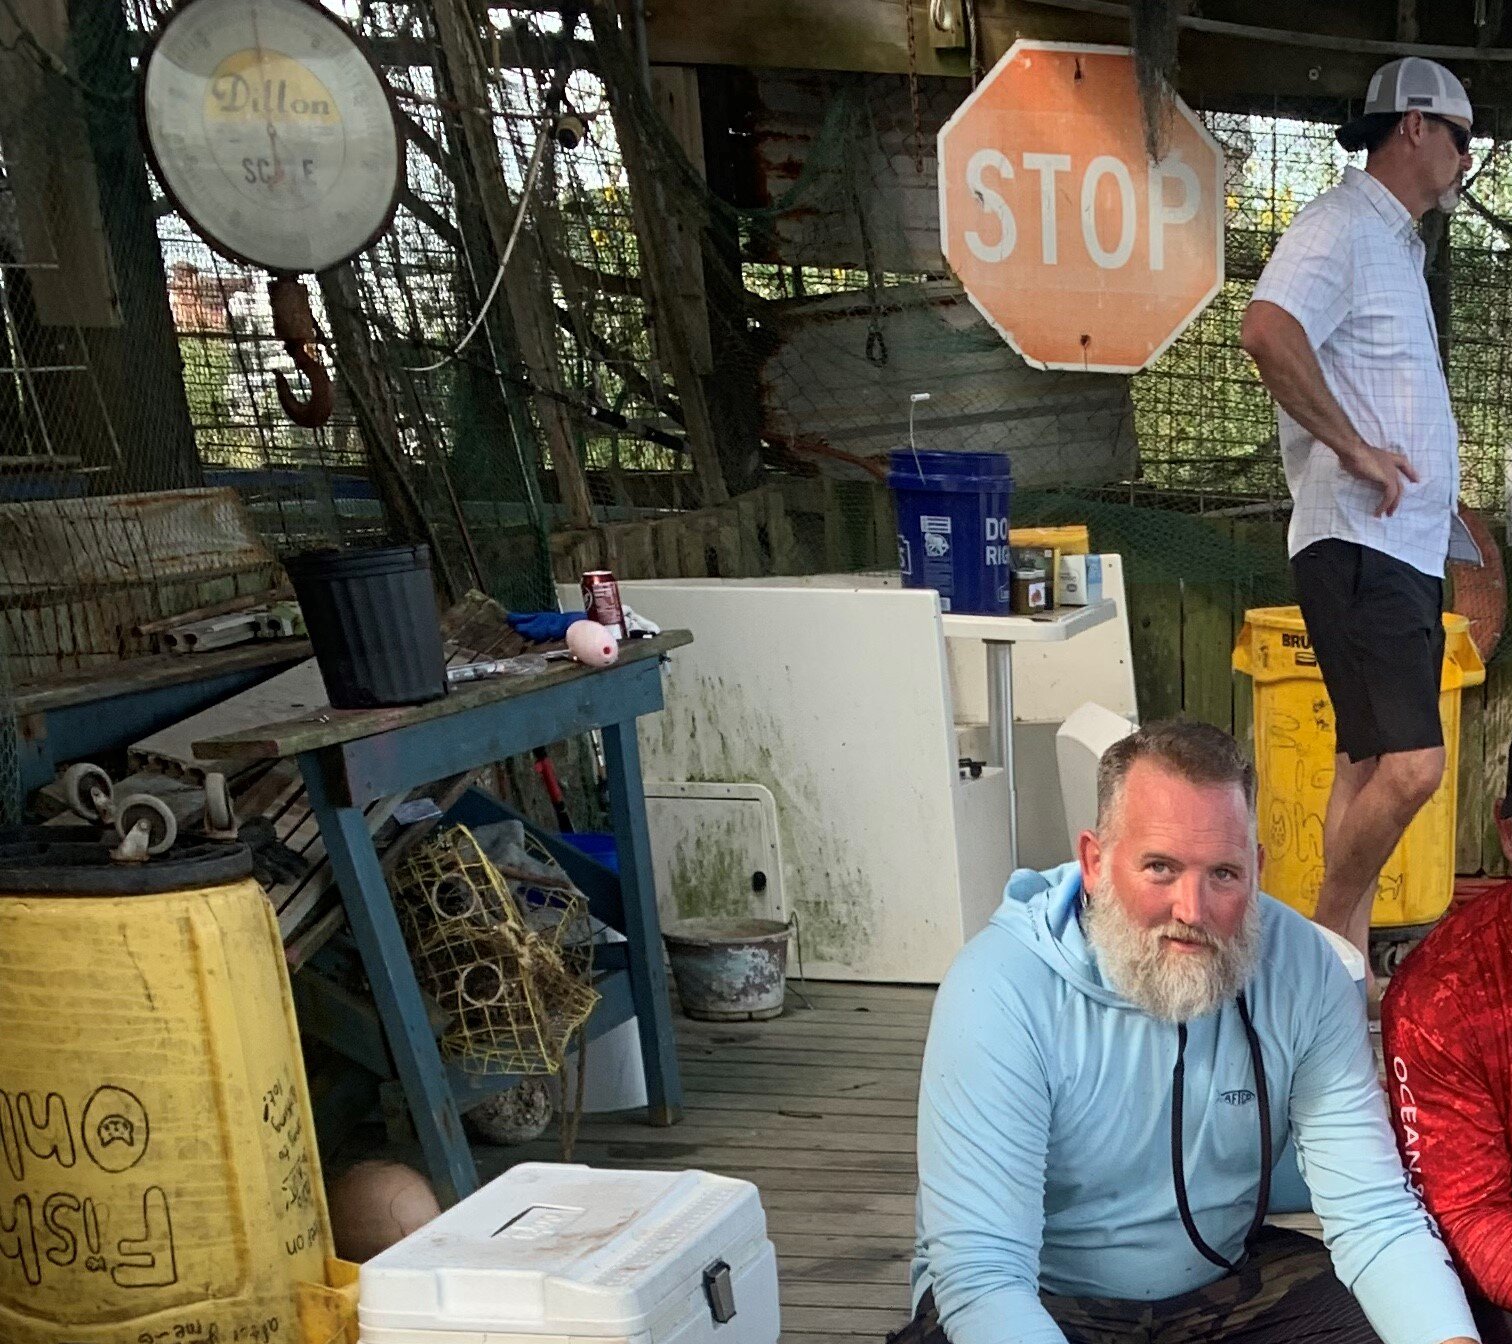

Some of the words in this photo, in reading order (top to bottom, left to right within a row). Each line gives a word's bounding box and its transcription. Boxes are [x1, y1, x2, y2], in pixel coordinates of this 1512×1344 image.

[212, 73, 330, 115] Dillon
[242, 158, 317, 184] SCE
[963, 148, 1201, 271] STOP
[0, 1186, 177, 1288] Fish
